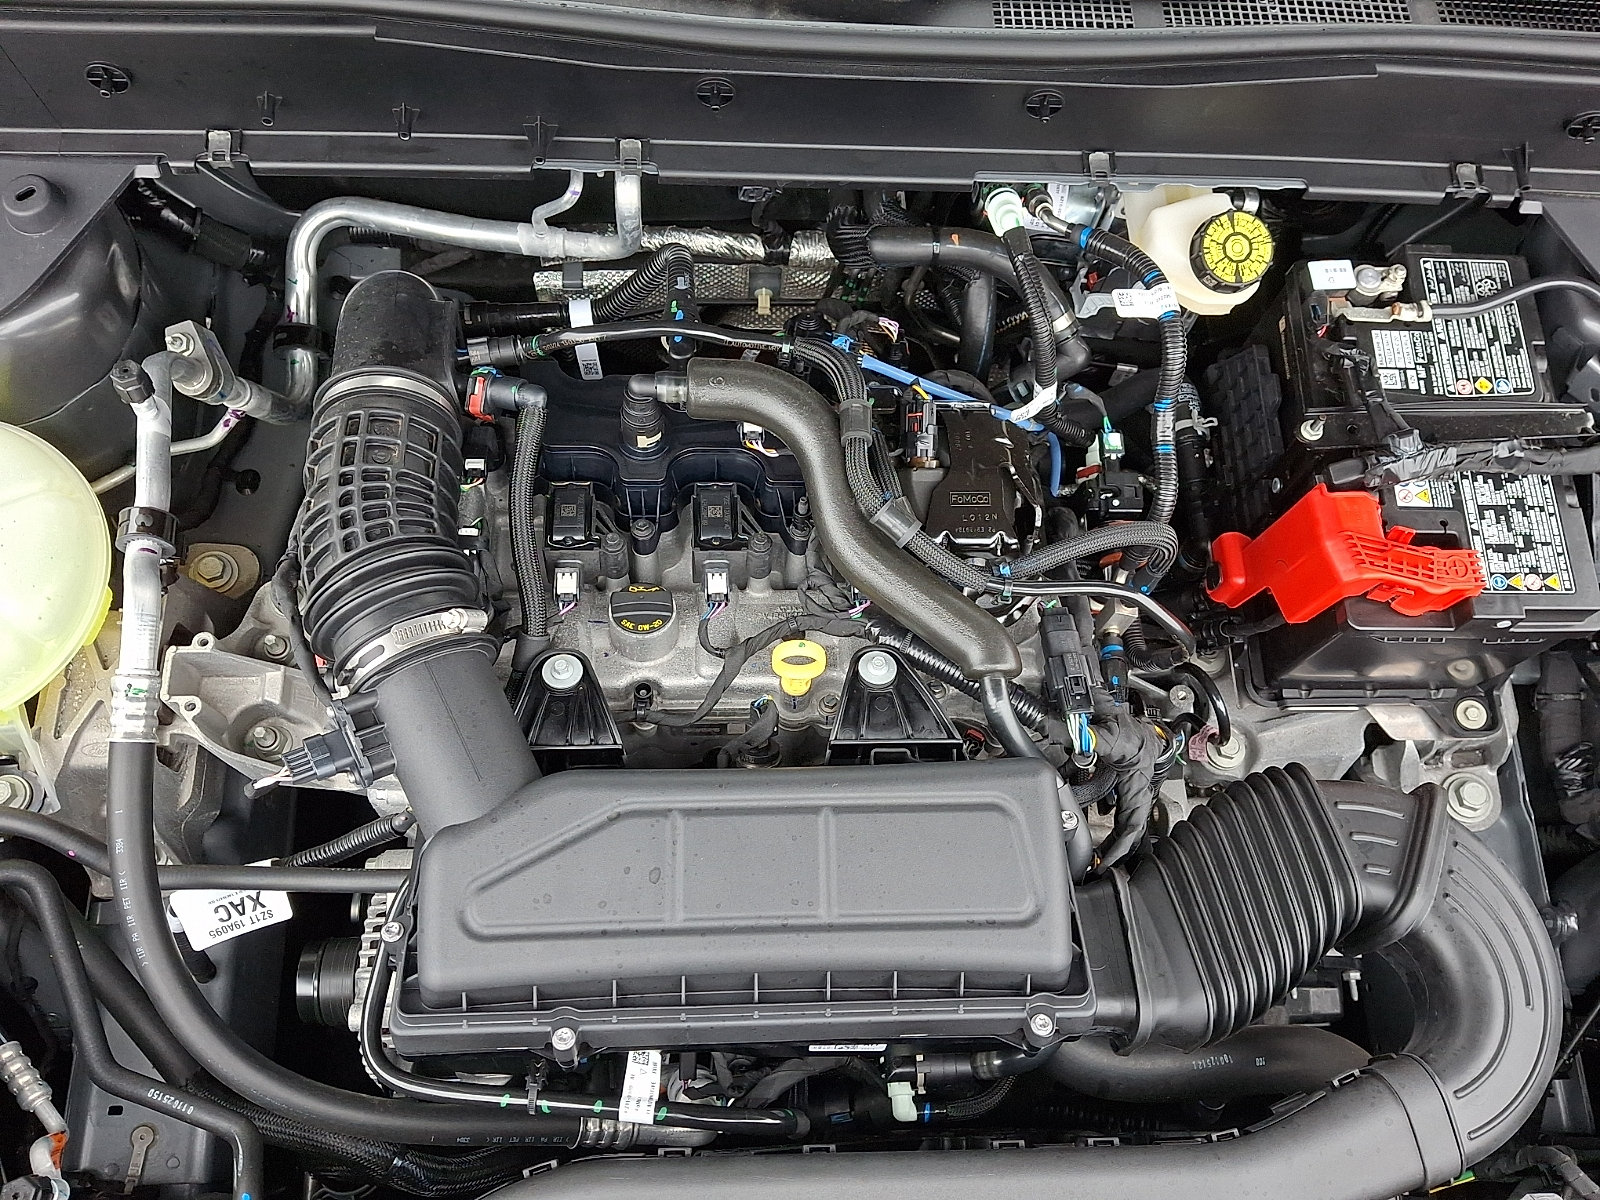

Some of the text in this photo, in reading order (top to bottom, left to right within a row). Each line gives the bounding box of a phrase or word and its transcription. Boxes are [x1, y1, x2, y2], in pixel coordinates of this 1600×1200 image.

[1413, 332, 1426, 362] FoMoCo
[951, 494, 989, 504] FoMoCo
[621, 619, 663, 631] SAE 0W-20
[122, 896, 132, 910] PET
[213, 890, 266, 923] XAC
[131, 931, 140, 942] PA
[208, 920, 246, 939] 19A095
